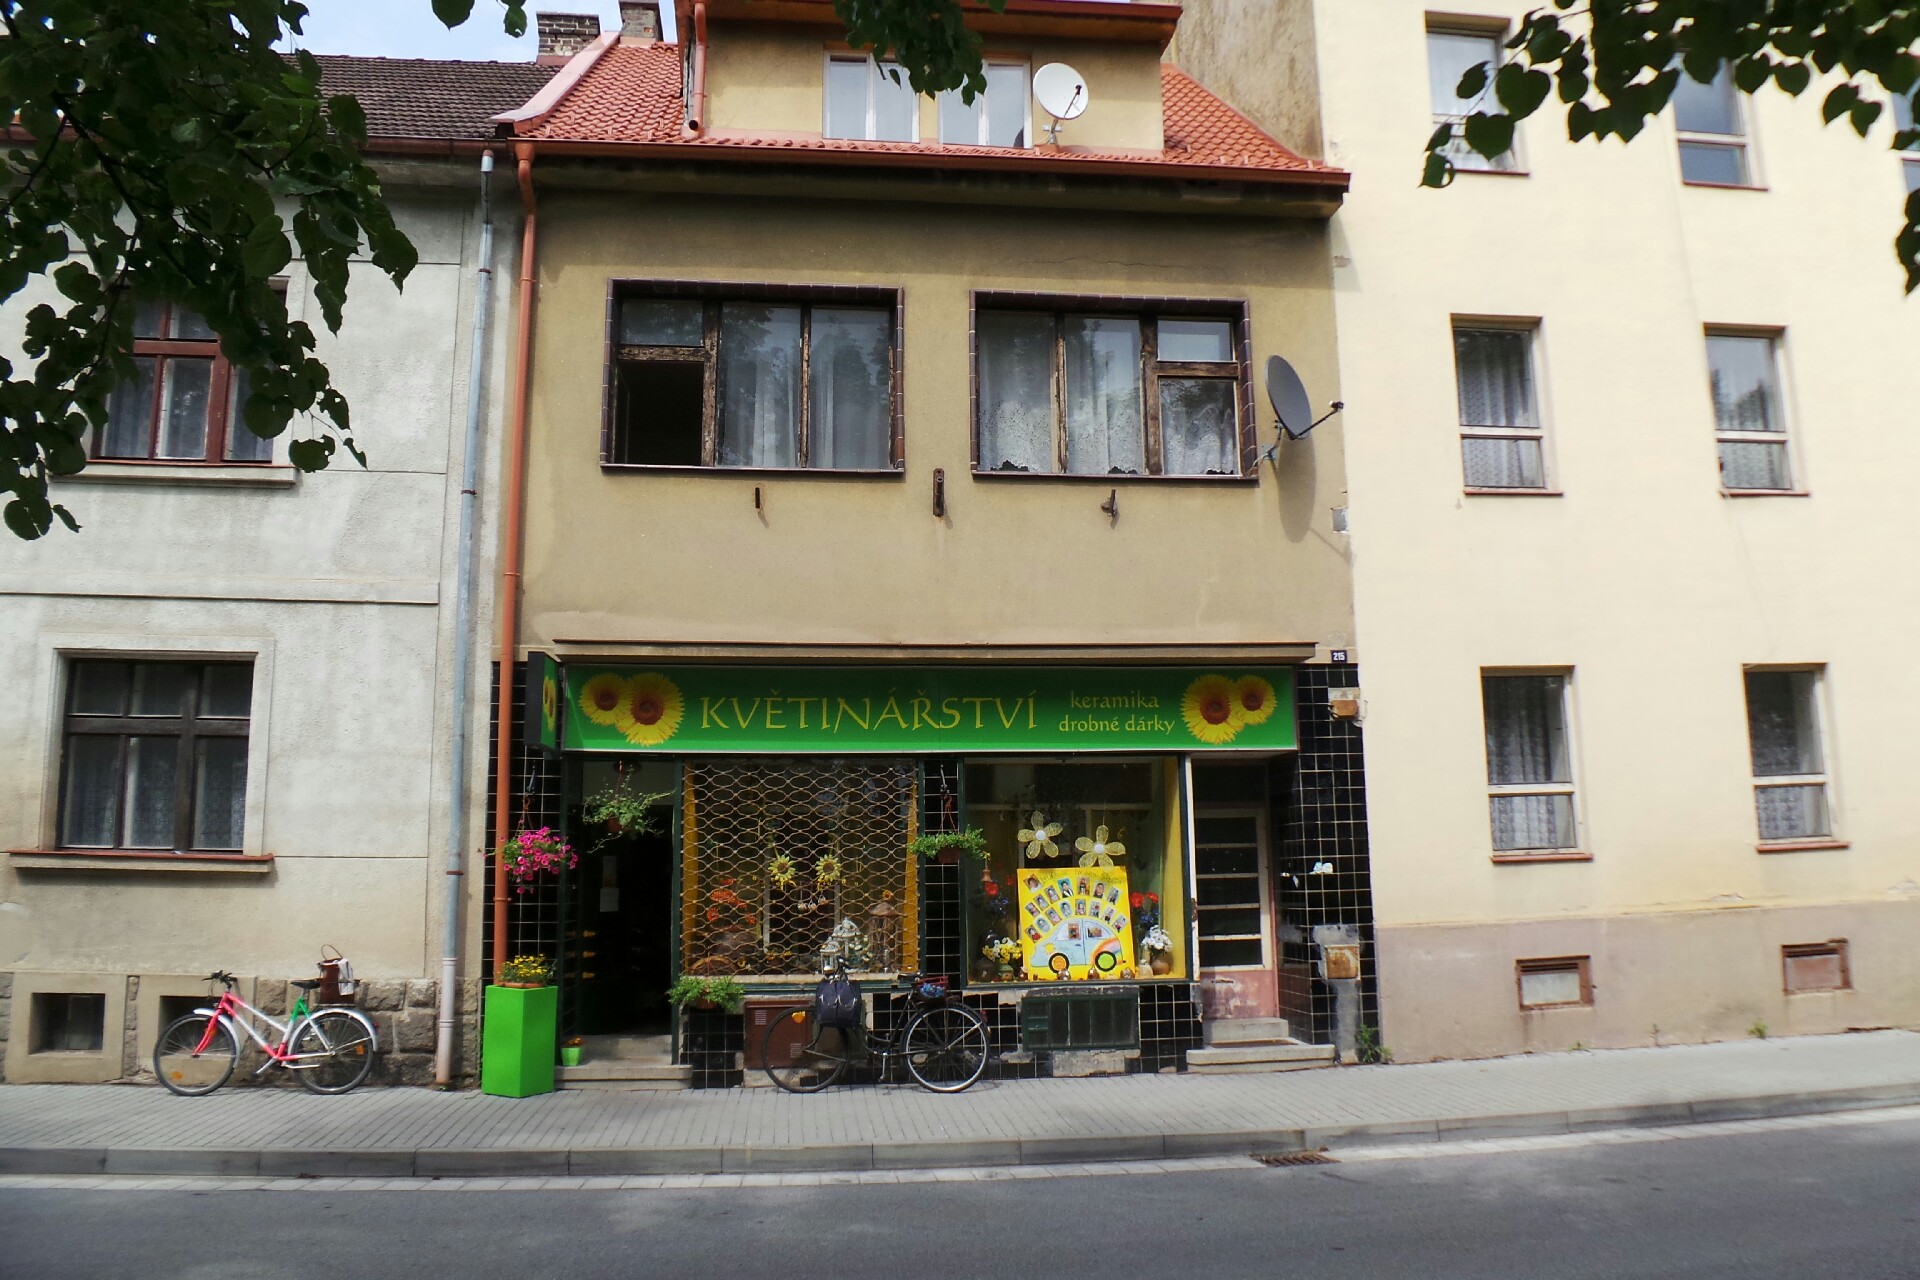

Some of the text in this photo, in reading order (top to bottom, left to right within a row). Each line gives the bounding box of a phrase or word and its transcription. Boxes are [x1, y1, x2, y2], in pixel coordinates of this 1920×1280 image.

[1332, 651, 1346, 661] 215
[1070, 690, 1160, 709] keramika
[699, 686, 1038, 734] KVĚTINÁŘSTVÍ
[1058, 714, 1176, 735] drobné dárky
